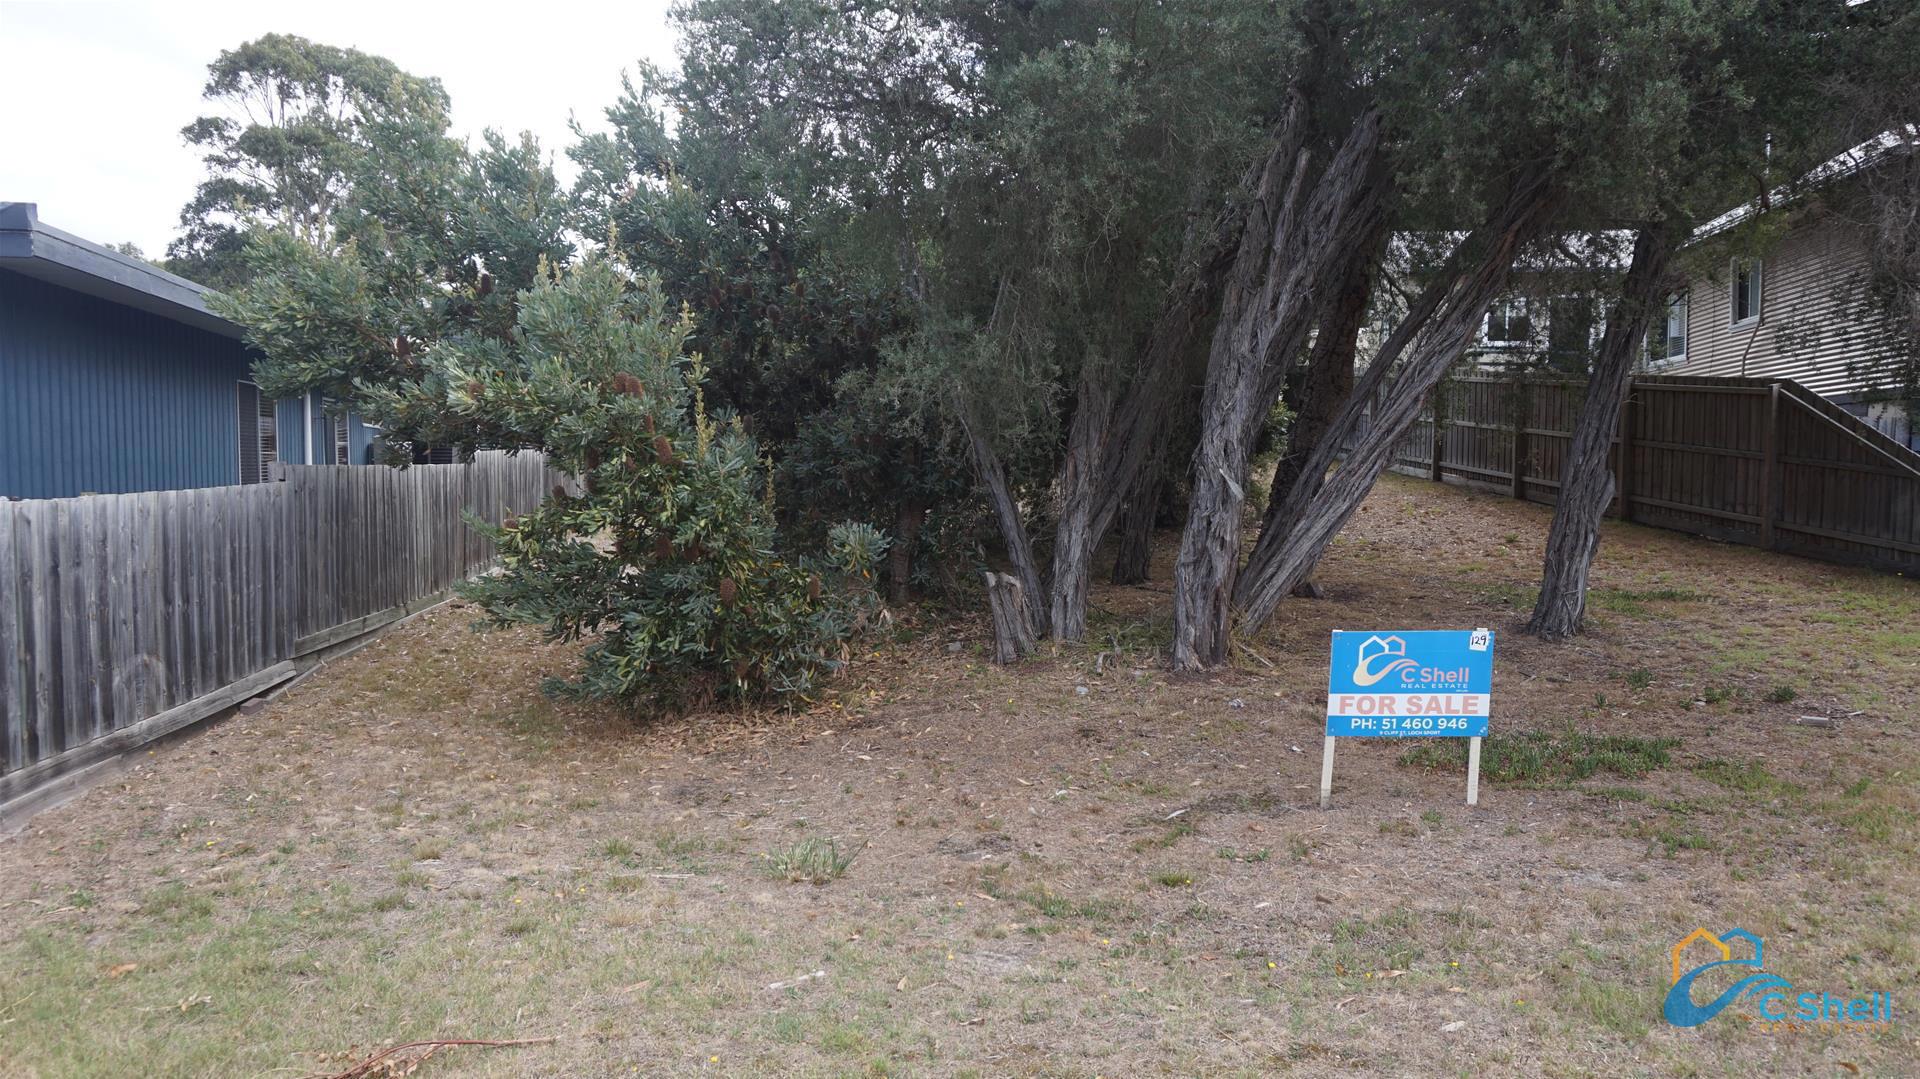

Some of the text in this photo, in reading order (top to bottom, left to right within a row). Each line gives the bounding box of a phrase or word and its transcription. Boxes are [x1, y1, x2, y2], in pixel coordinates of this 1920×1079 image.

[1471, 635, 1487, 646] 129
[1401, 667, 1470, 683] C Shell
[1338, 695, 1479, 715] FOR SALE
[1350, 718, 1468, 730] PH: 51 460 946
